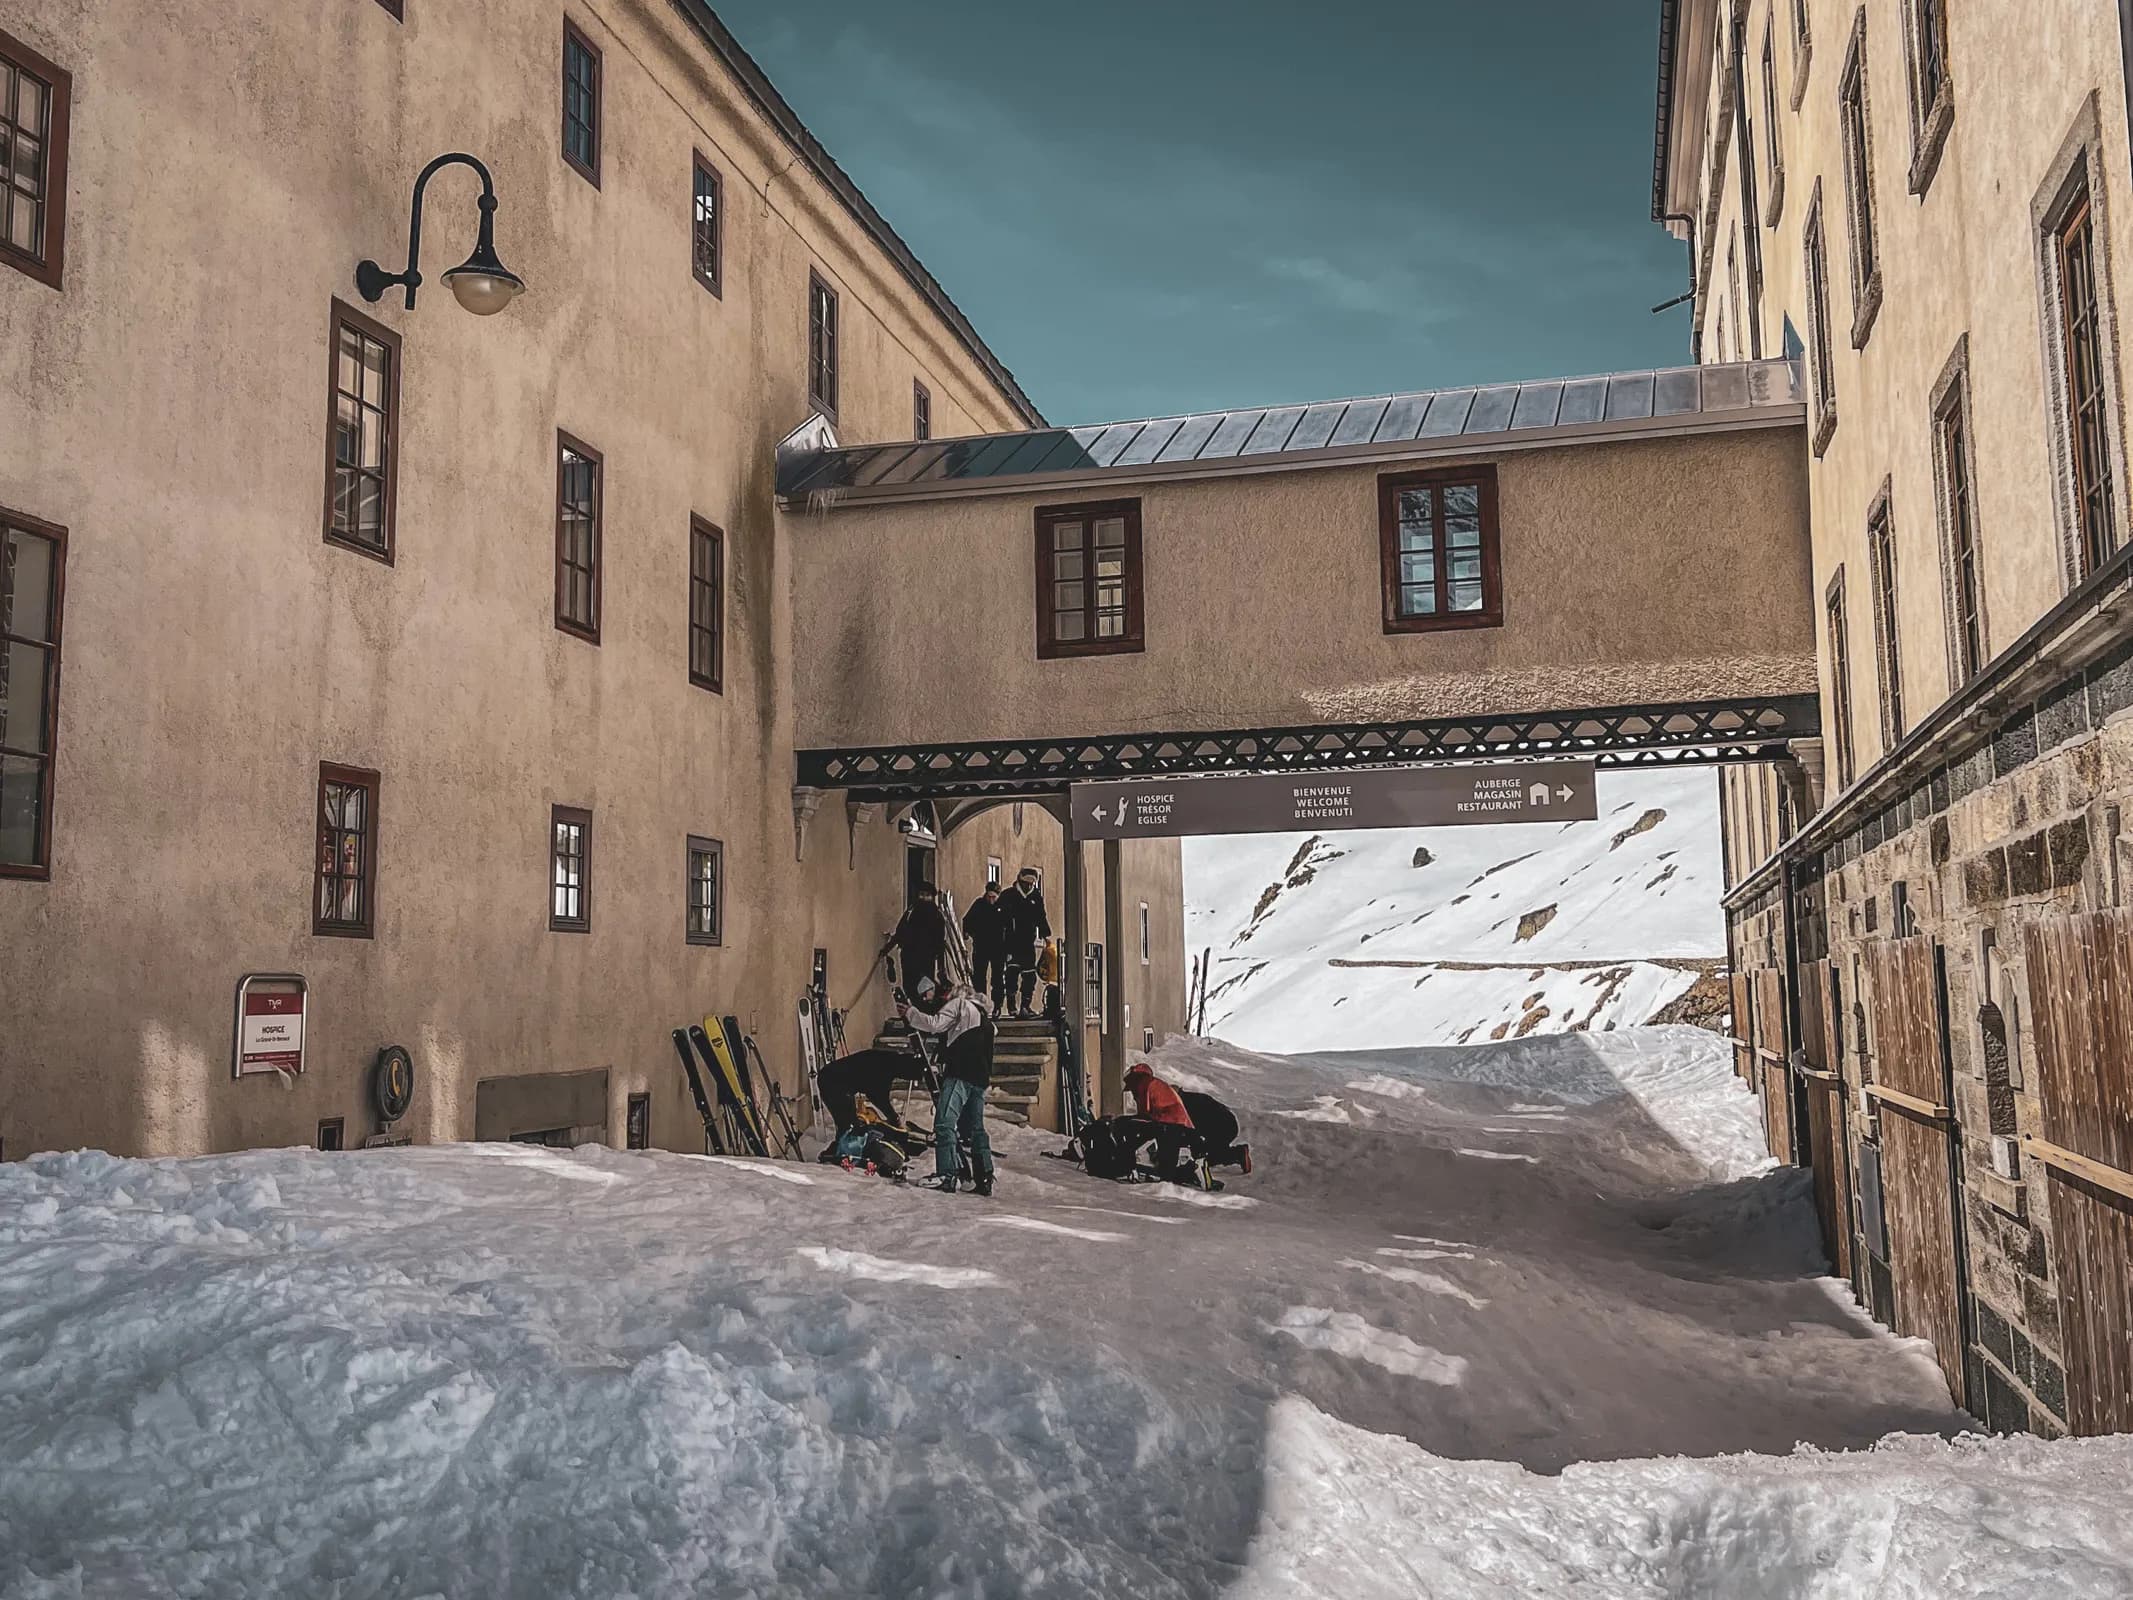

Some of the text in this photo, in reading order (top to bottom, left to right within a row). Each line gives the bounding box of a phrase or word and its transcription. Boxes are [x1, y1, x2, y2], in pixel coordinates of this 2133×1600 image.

[1474, 779, 1521, 789] AUBERGE
[1293, 786, 1352, 797] BIENVENUE
[1473, 790, 1522, 800] MAGASIN
[1136, 794, 1175, 804] HOSPICE
[1296, 797, 1350, 807] WELCOME
[1136, 804, 1172, 815] TRÉSOR
[1457, 801, 1523, 812] RESTAURANT
[1294, 807, 1353, 818] BENVENUTI
[1137, 815, 1168, 825] EGLISE
[262, 1025, 285, 1034] HOSPICE
